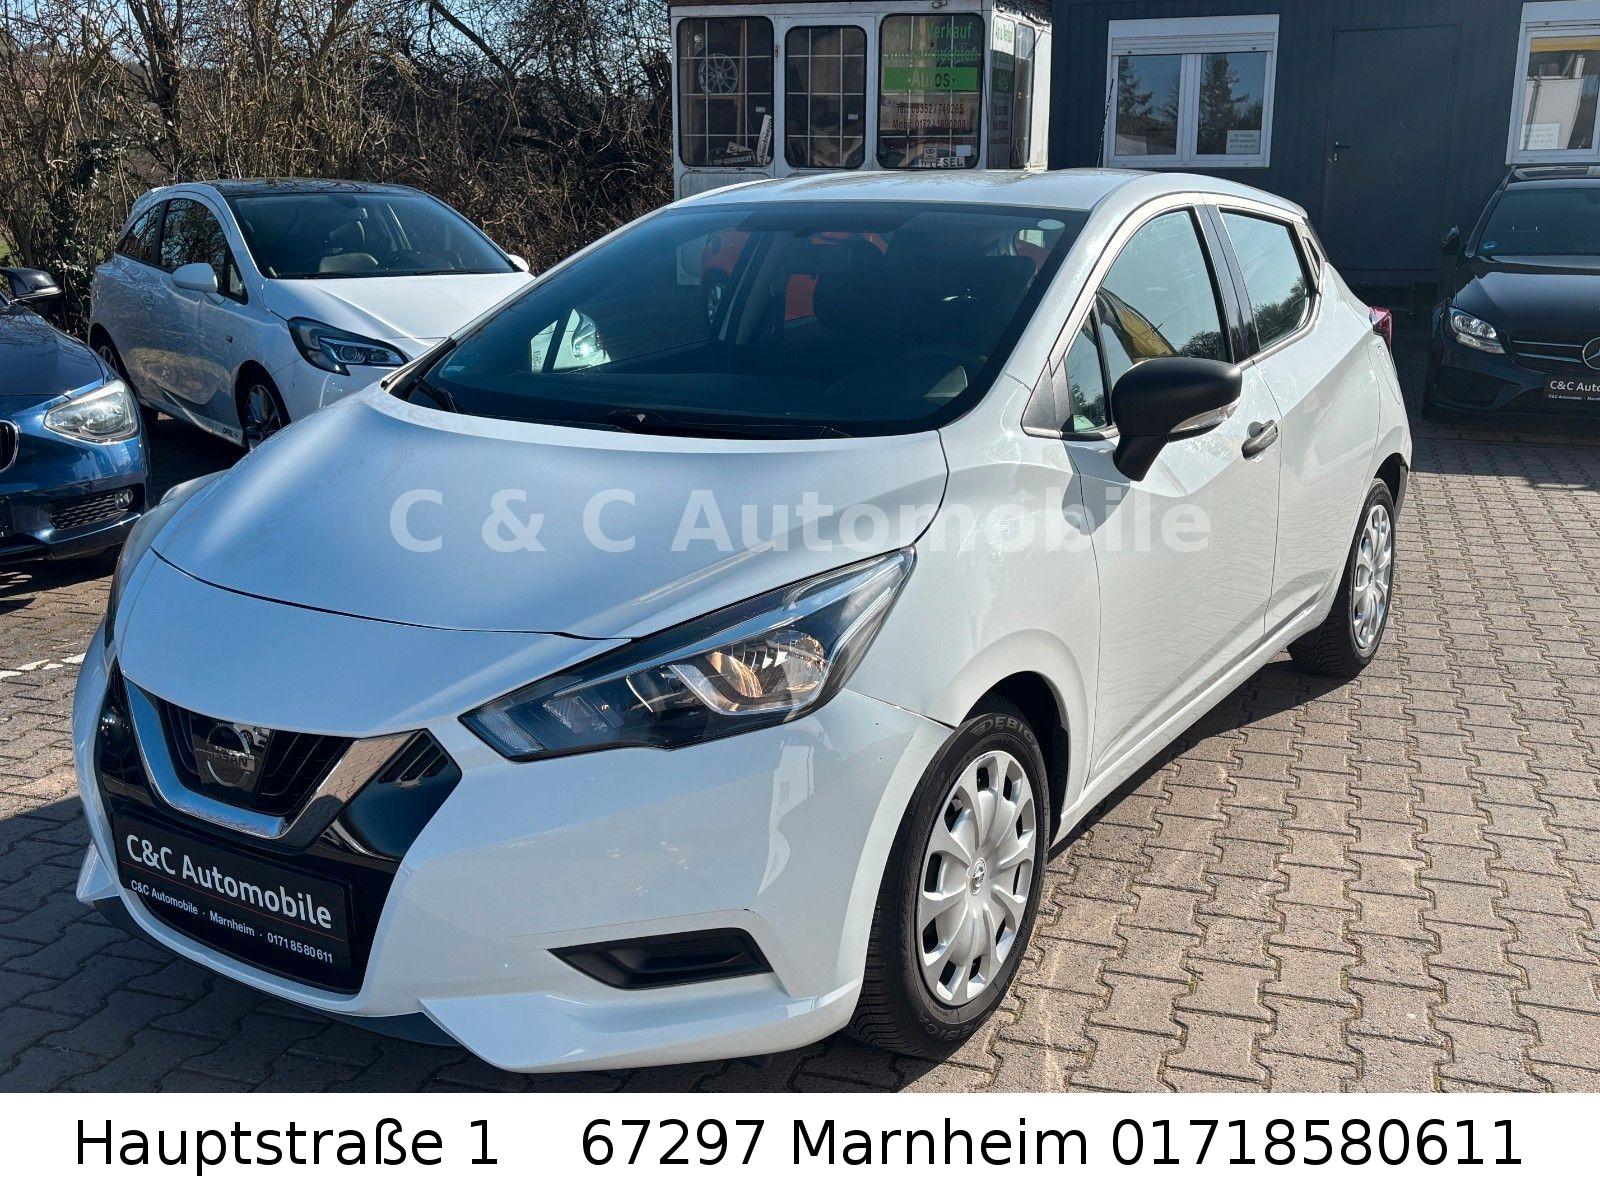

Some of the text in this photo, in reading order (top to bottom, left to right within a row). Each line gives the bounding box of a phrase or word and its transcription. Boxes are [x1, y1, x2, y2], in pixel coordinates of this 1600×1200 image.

[926, 21, 973, 40] Verkauf
[1550, 380, 1574, 390] C&C
[126, 834, 332, 929] C&C Automobile
[131, 880, 150, 896] C&C
[152, 888, 199, 915] Automobile
[210, 910, 255, 937] Marnheim
